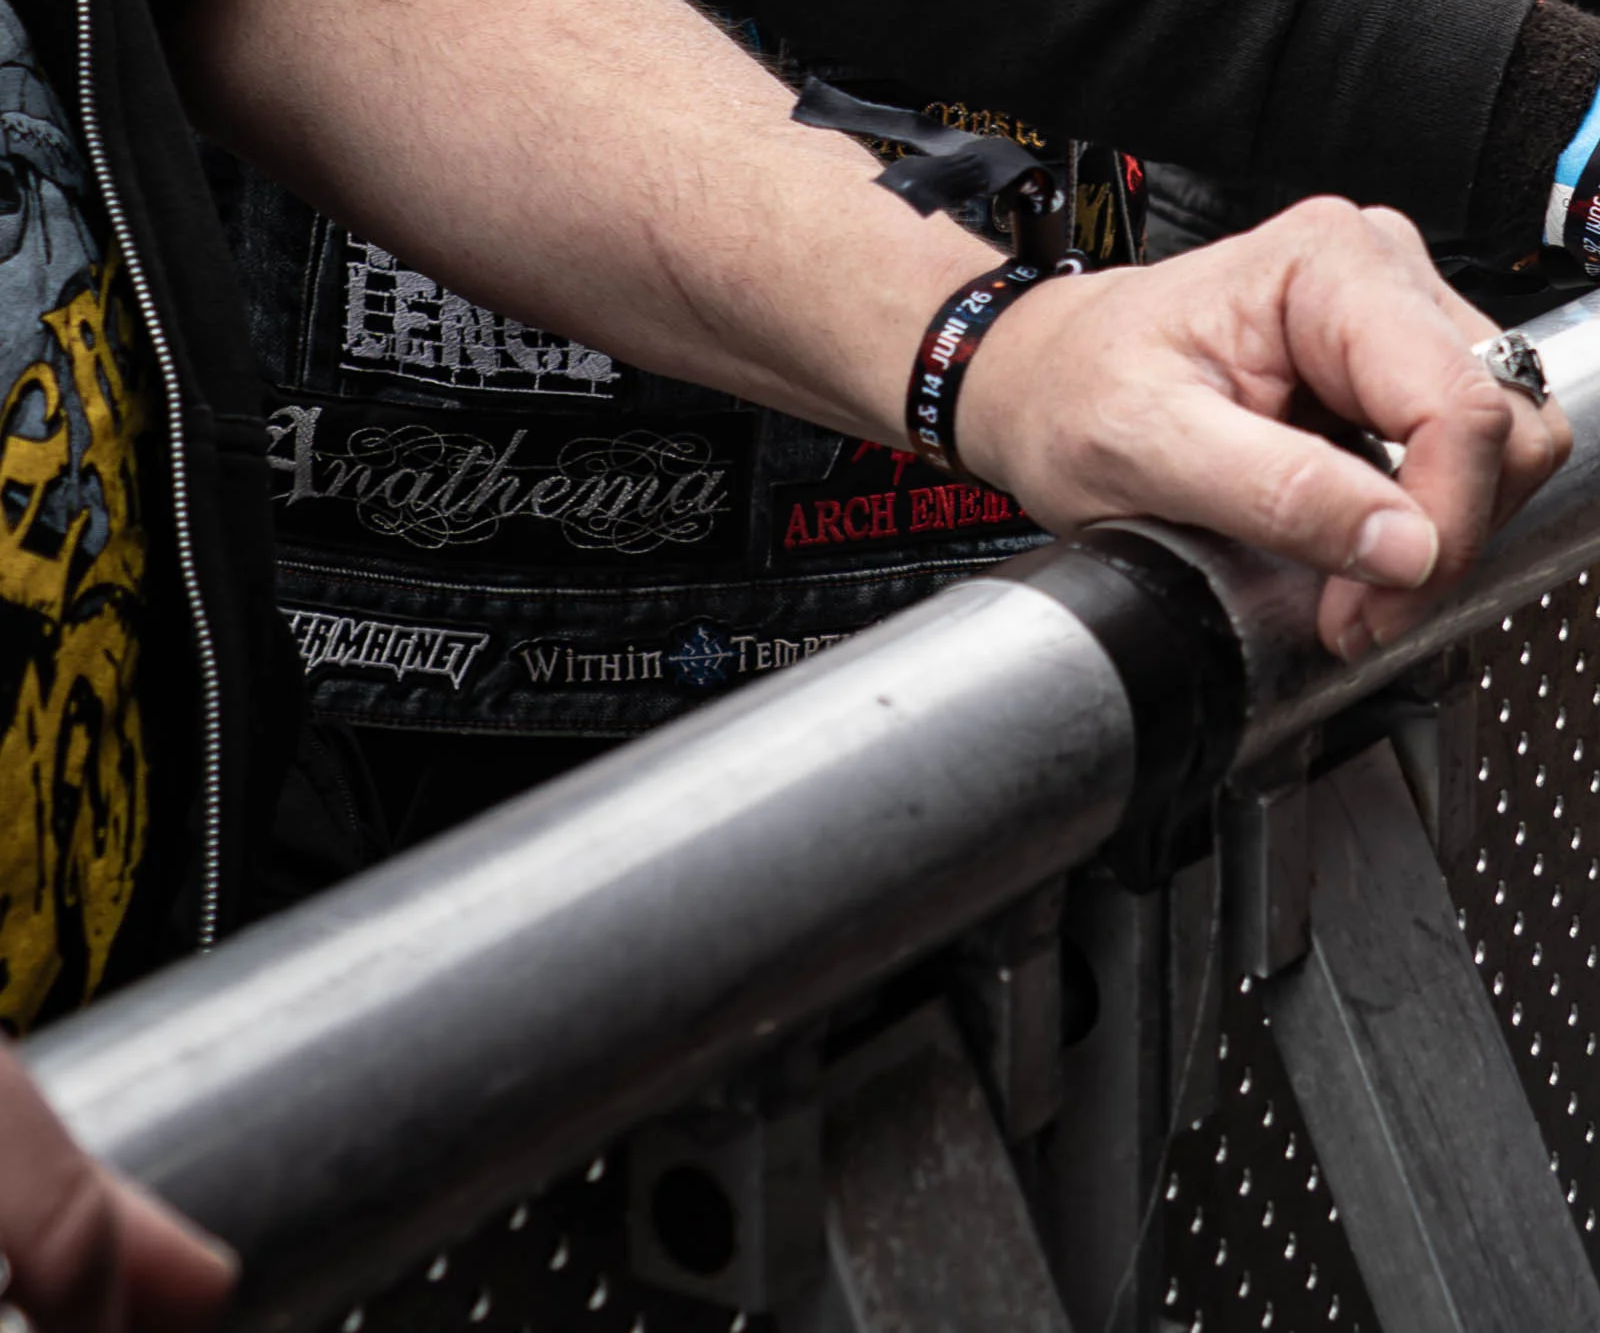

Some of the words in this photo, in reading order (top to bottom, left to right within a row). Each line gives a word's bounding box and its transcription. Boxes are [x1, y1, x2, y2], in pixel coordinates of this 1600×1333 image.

[930, 316, 968, 370] JUNI
[921, 373, 944, 398] 14
[918, 404, 938, 424] &
[266, 404, 732, 523] Anathema
[783, 492, 898, 549] ARCH
[908, 484, 1029, 532] ENEM
